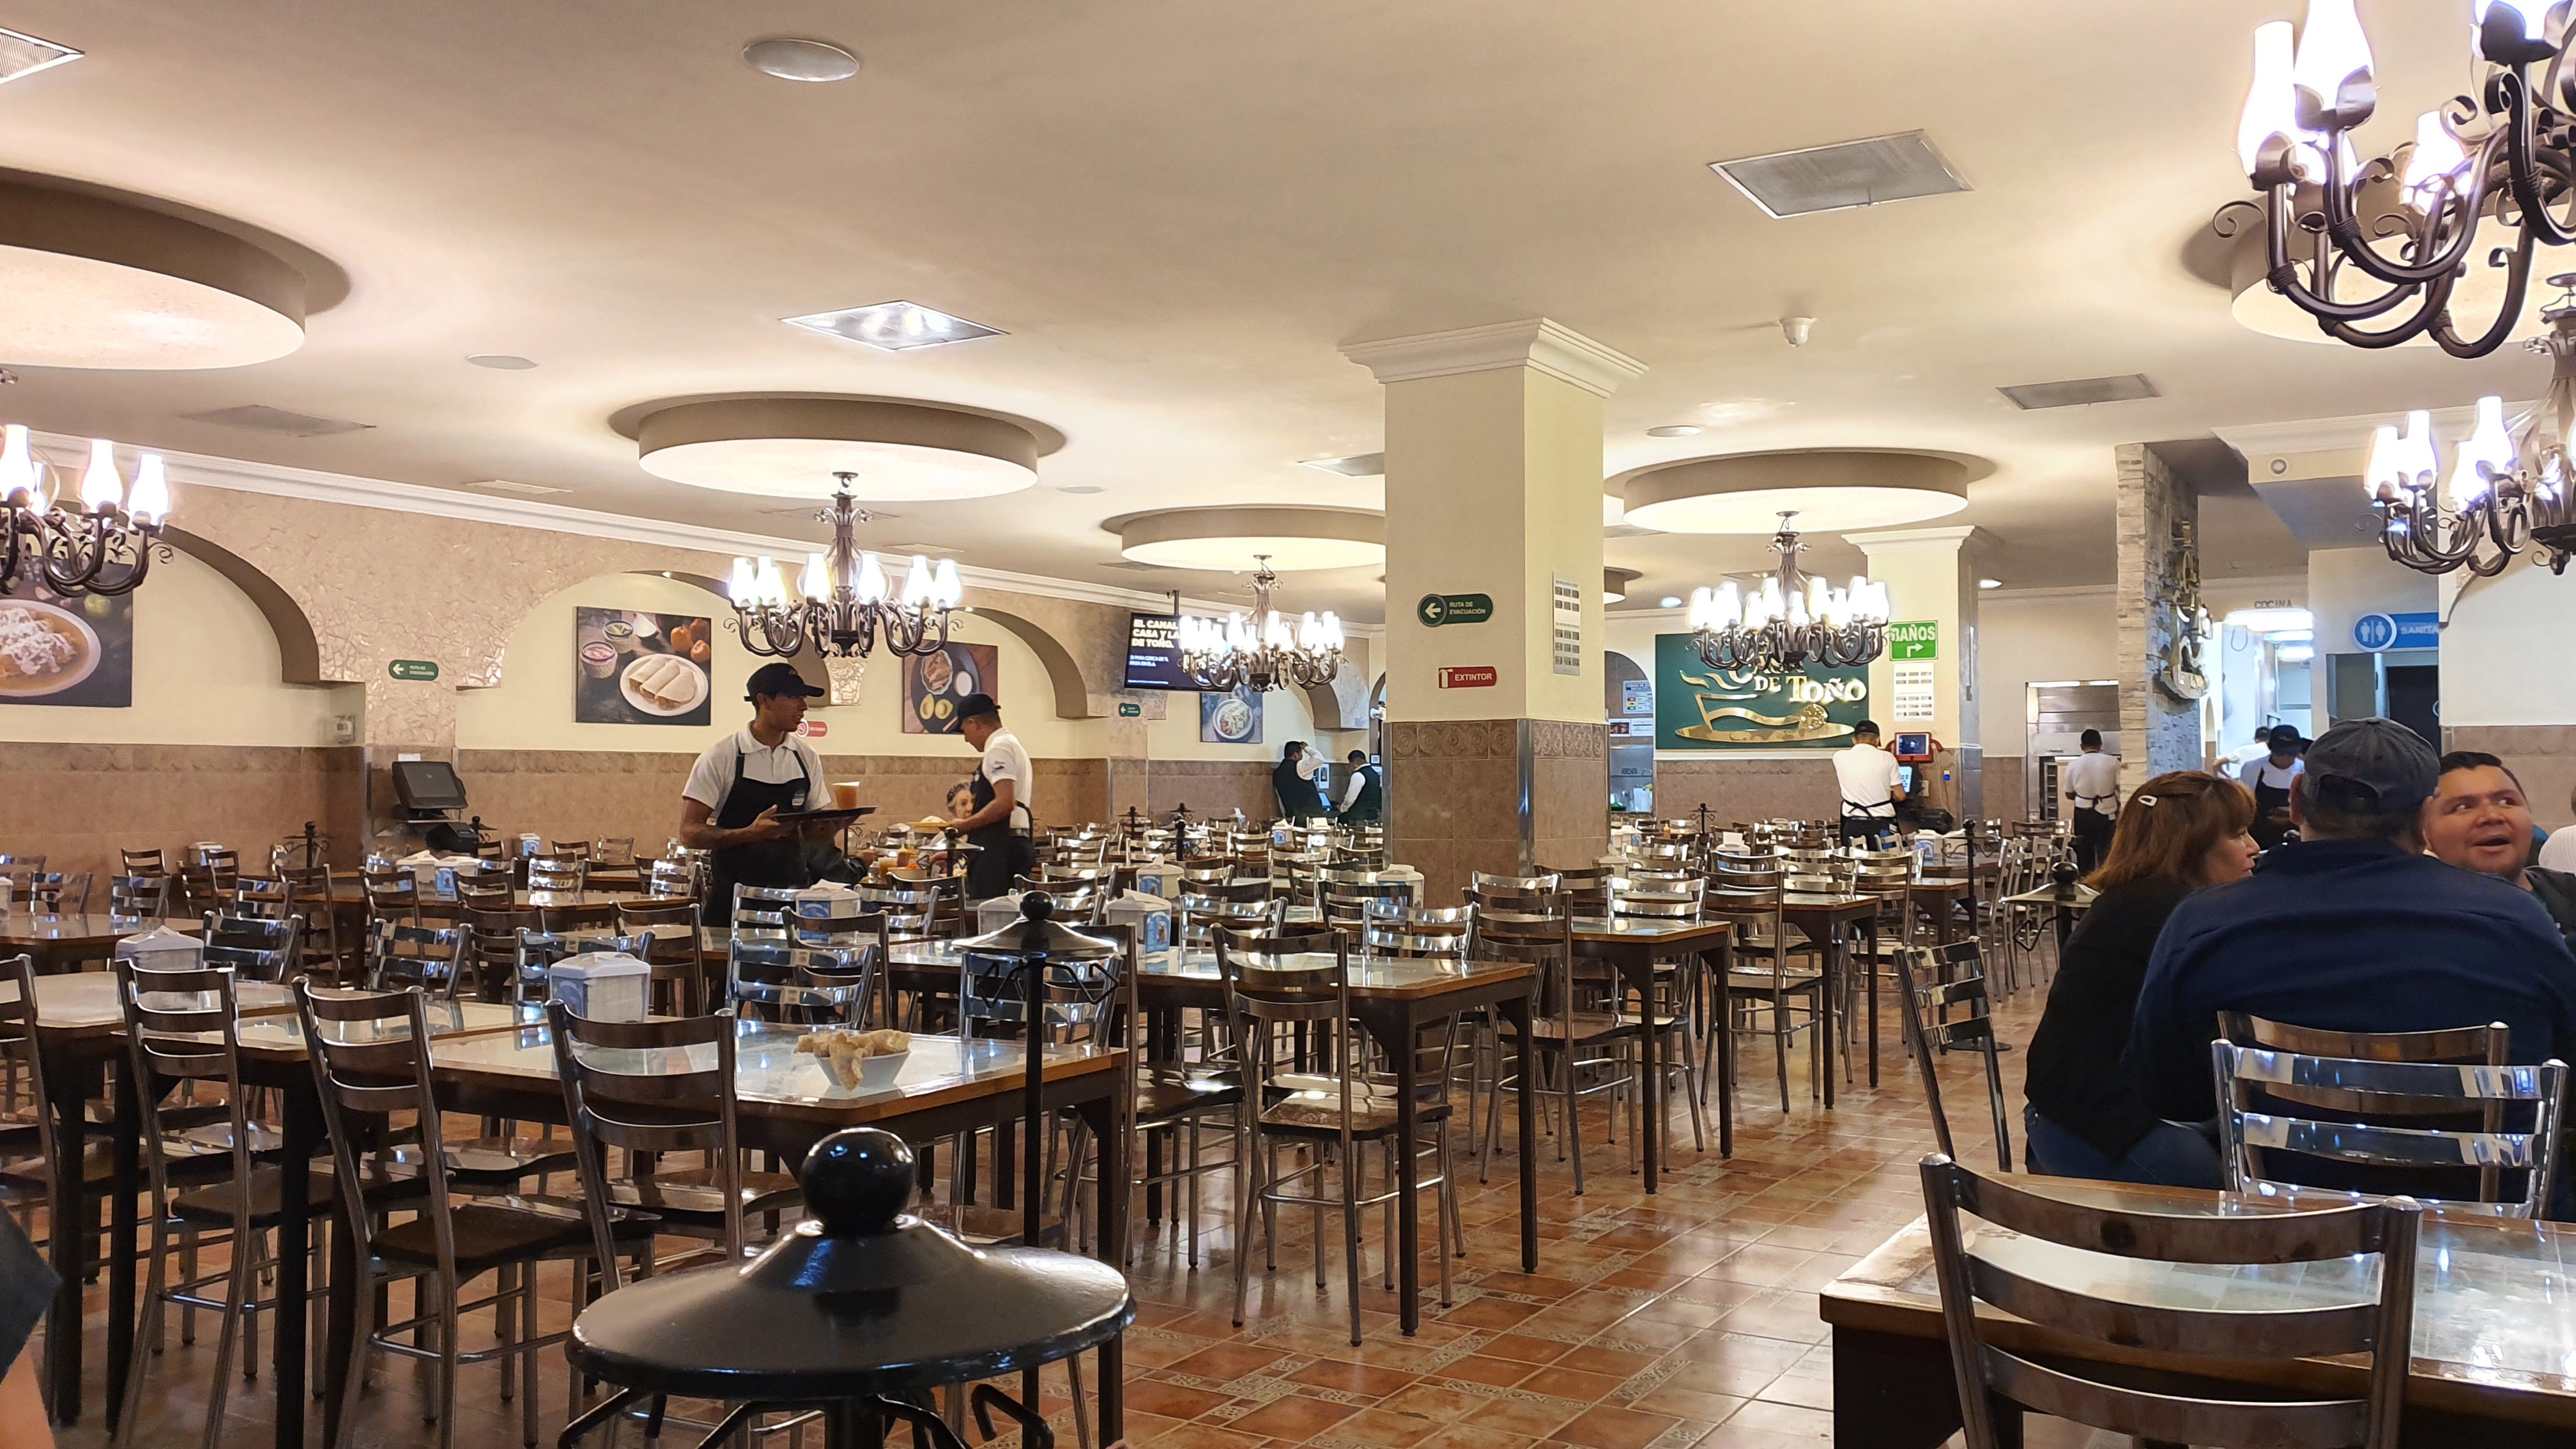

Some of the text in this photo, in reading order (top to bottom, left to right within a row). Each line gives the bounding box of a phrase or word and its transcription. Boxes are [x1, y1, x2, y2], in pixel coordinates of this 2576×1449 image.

[2254, 599, 2293, 608] COCINA
[1133, 619, 1179, 630] EL CANAL
[1133, 629, 1158, 638] CASA
[1160, 630, 1167, 638] Y
[1131, 638, 1145, 647] DE
[1455, 673, 1492, 681] EXTINTOR
[1753, 675, 1867, 703] DE TOÑO
